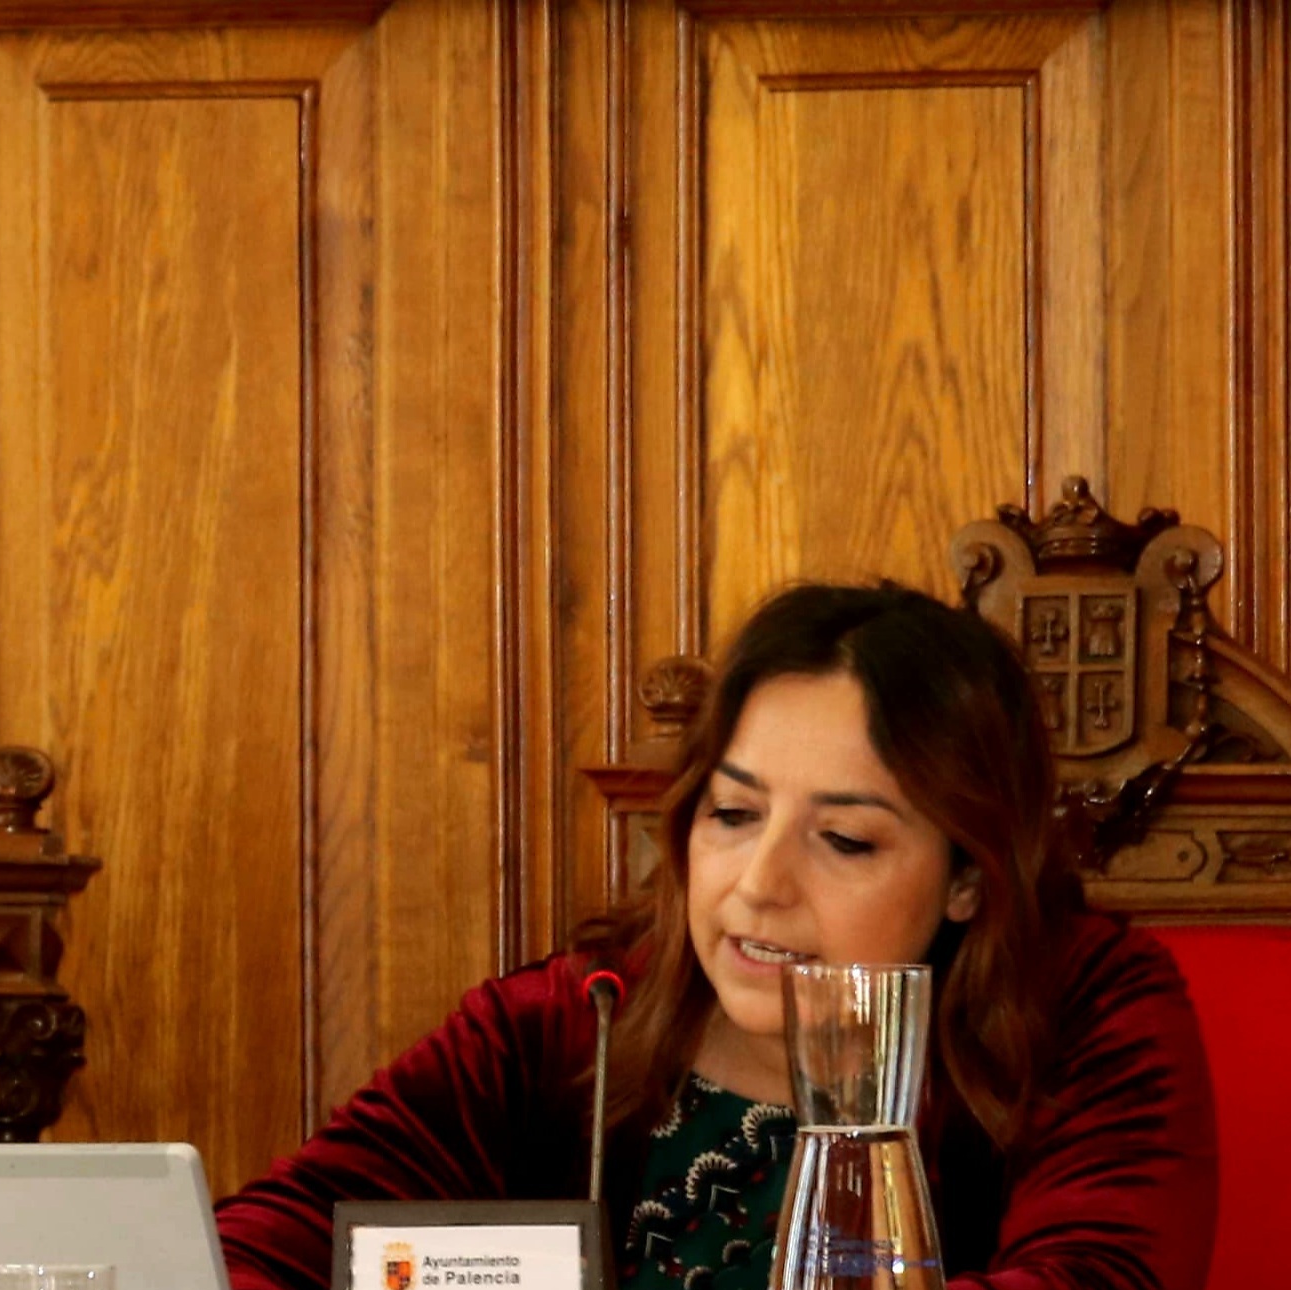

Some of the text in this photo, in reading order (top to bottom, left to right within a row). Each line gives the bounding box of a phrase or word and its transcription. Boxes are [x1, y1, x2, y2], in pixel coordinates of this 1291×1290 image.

[422, 1256, 520, 1269] Ayuntamiento
[422, 1270, 520, 1285] de Palencia
